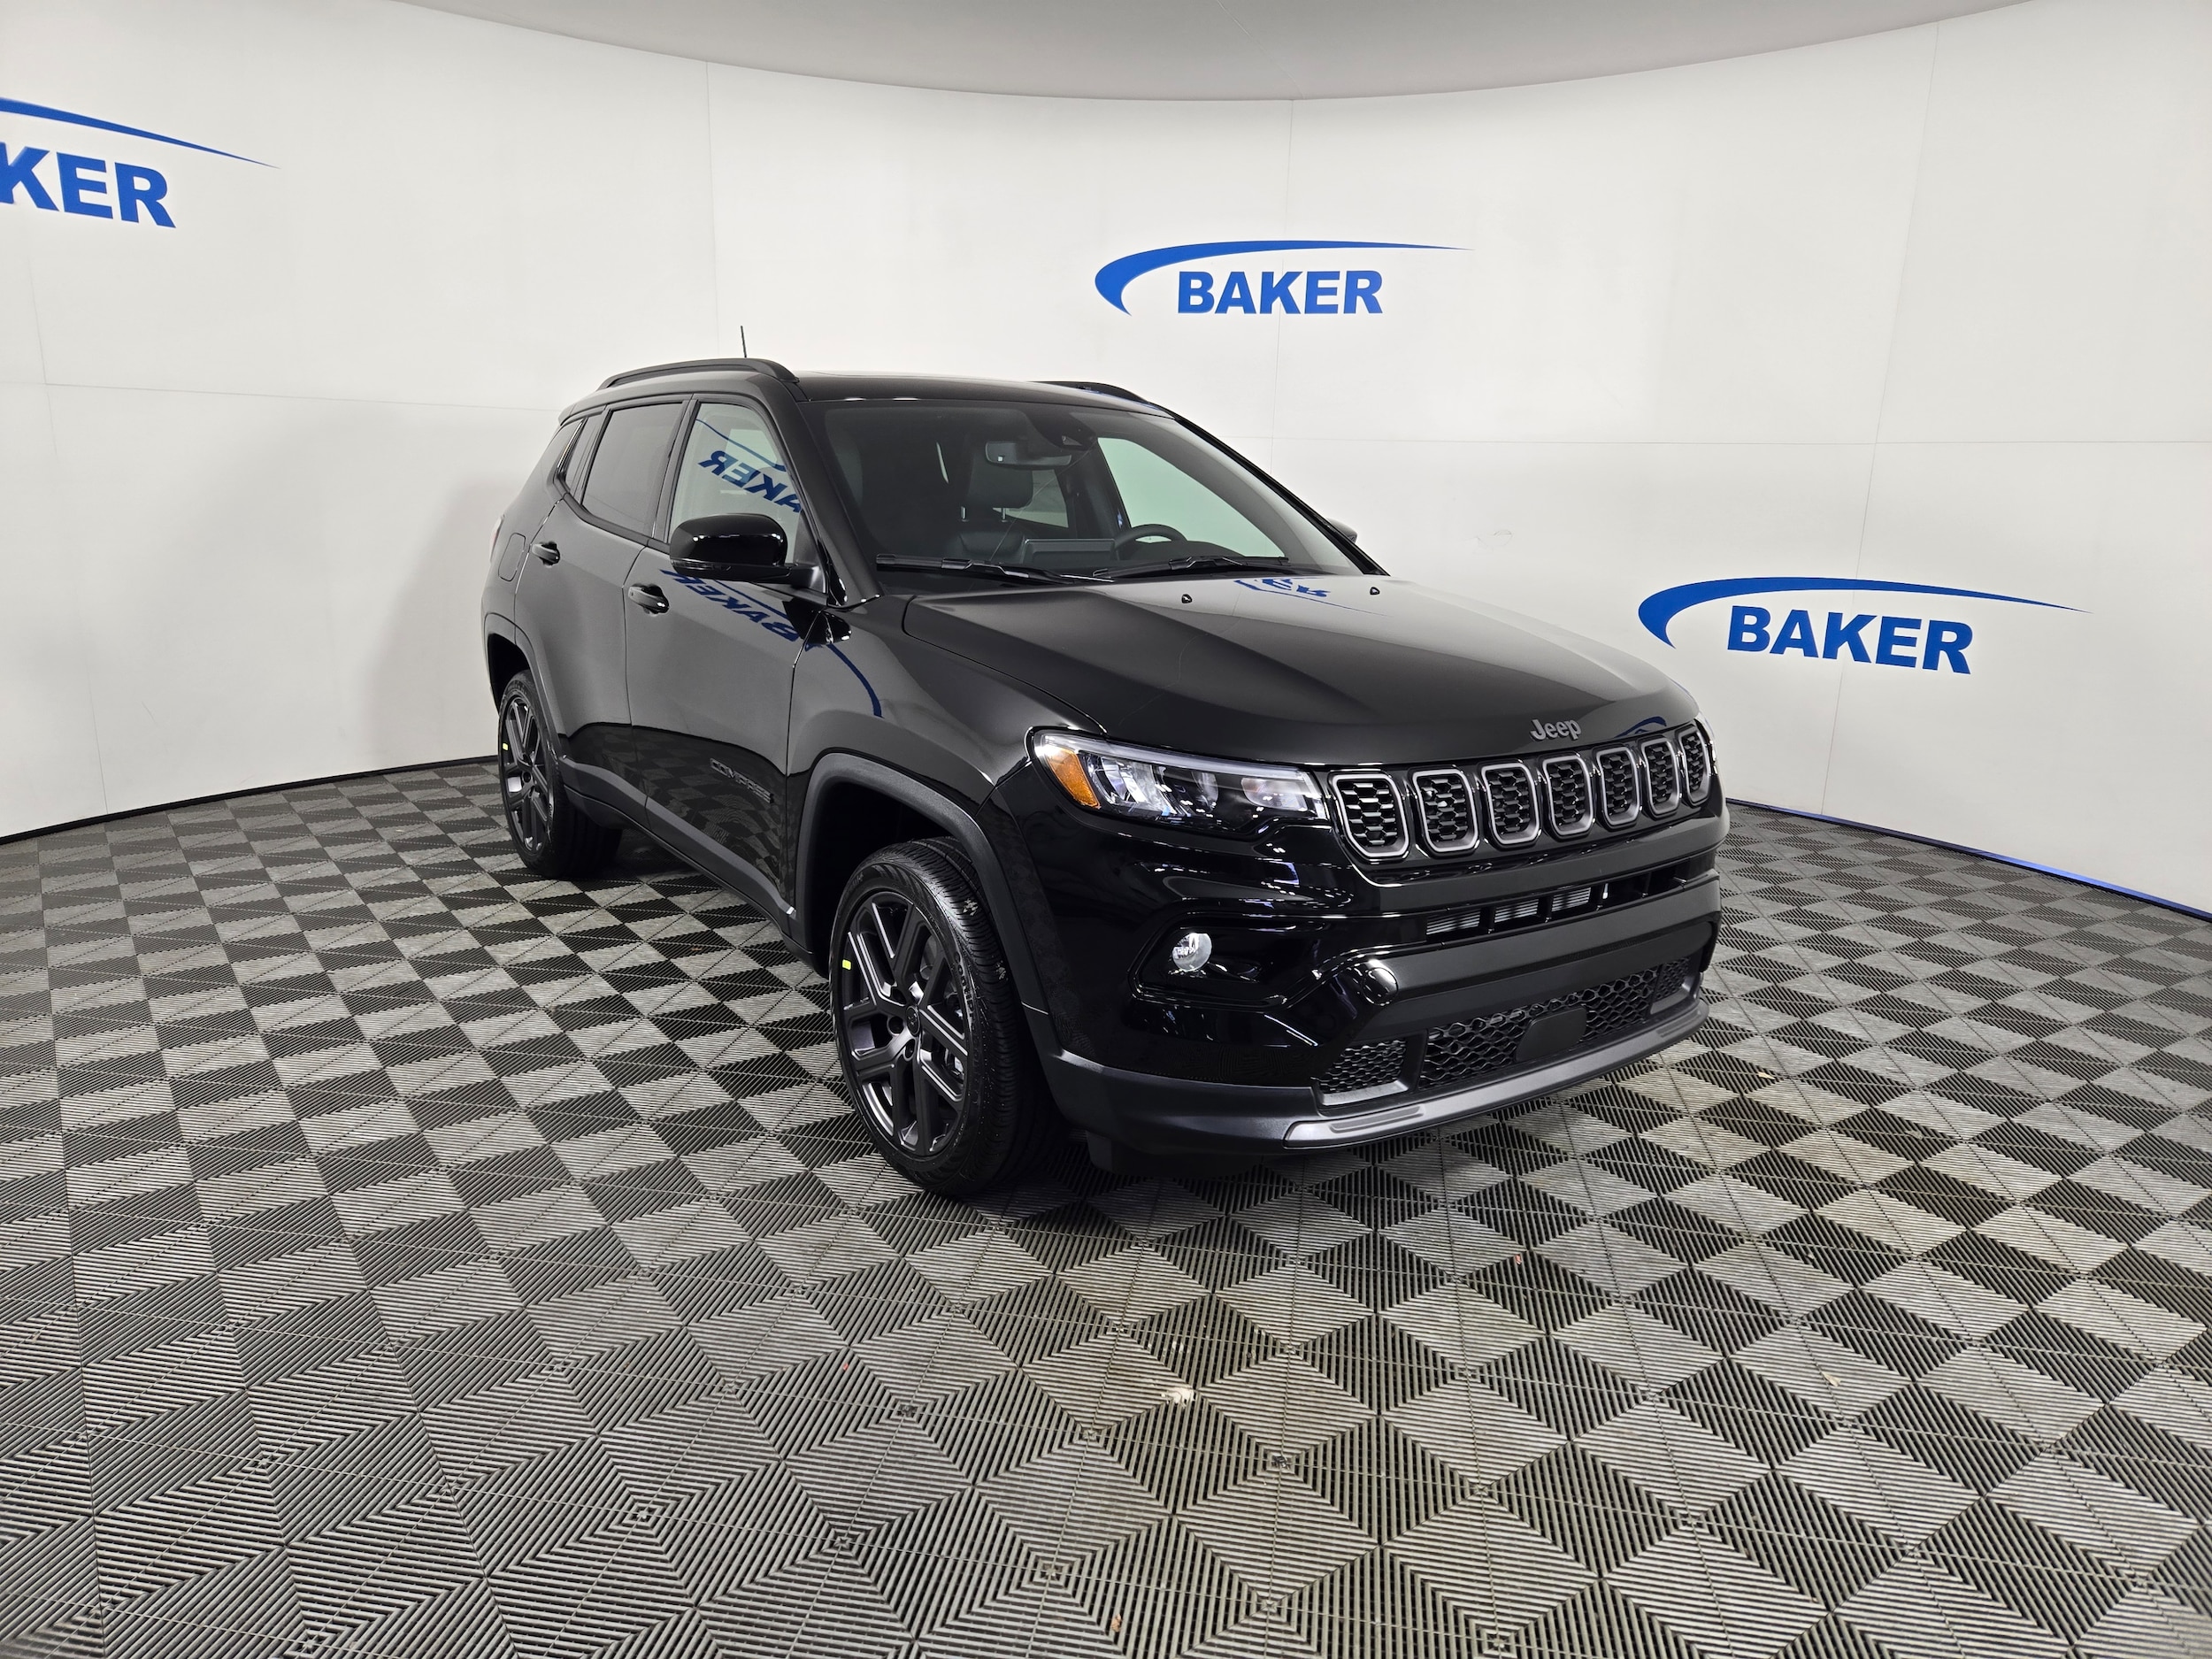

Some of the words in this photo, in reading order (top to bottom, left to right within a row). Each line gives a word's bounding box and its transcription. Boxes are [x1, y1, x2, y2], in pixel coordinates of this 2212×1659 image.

[1178, 270, 1383, 314] BAKER
[1727, 605, 1974, 674] BAKER
[1531, 718, 1581, 741] Jeep
